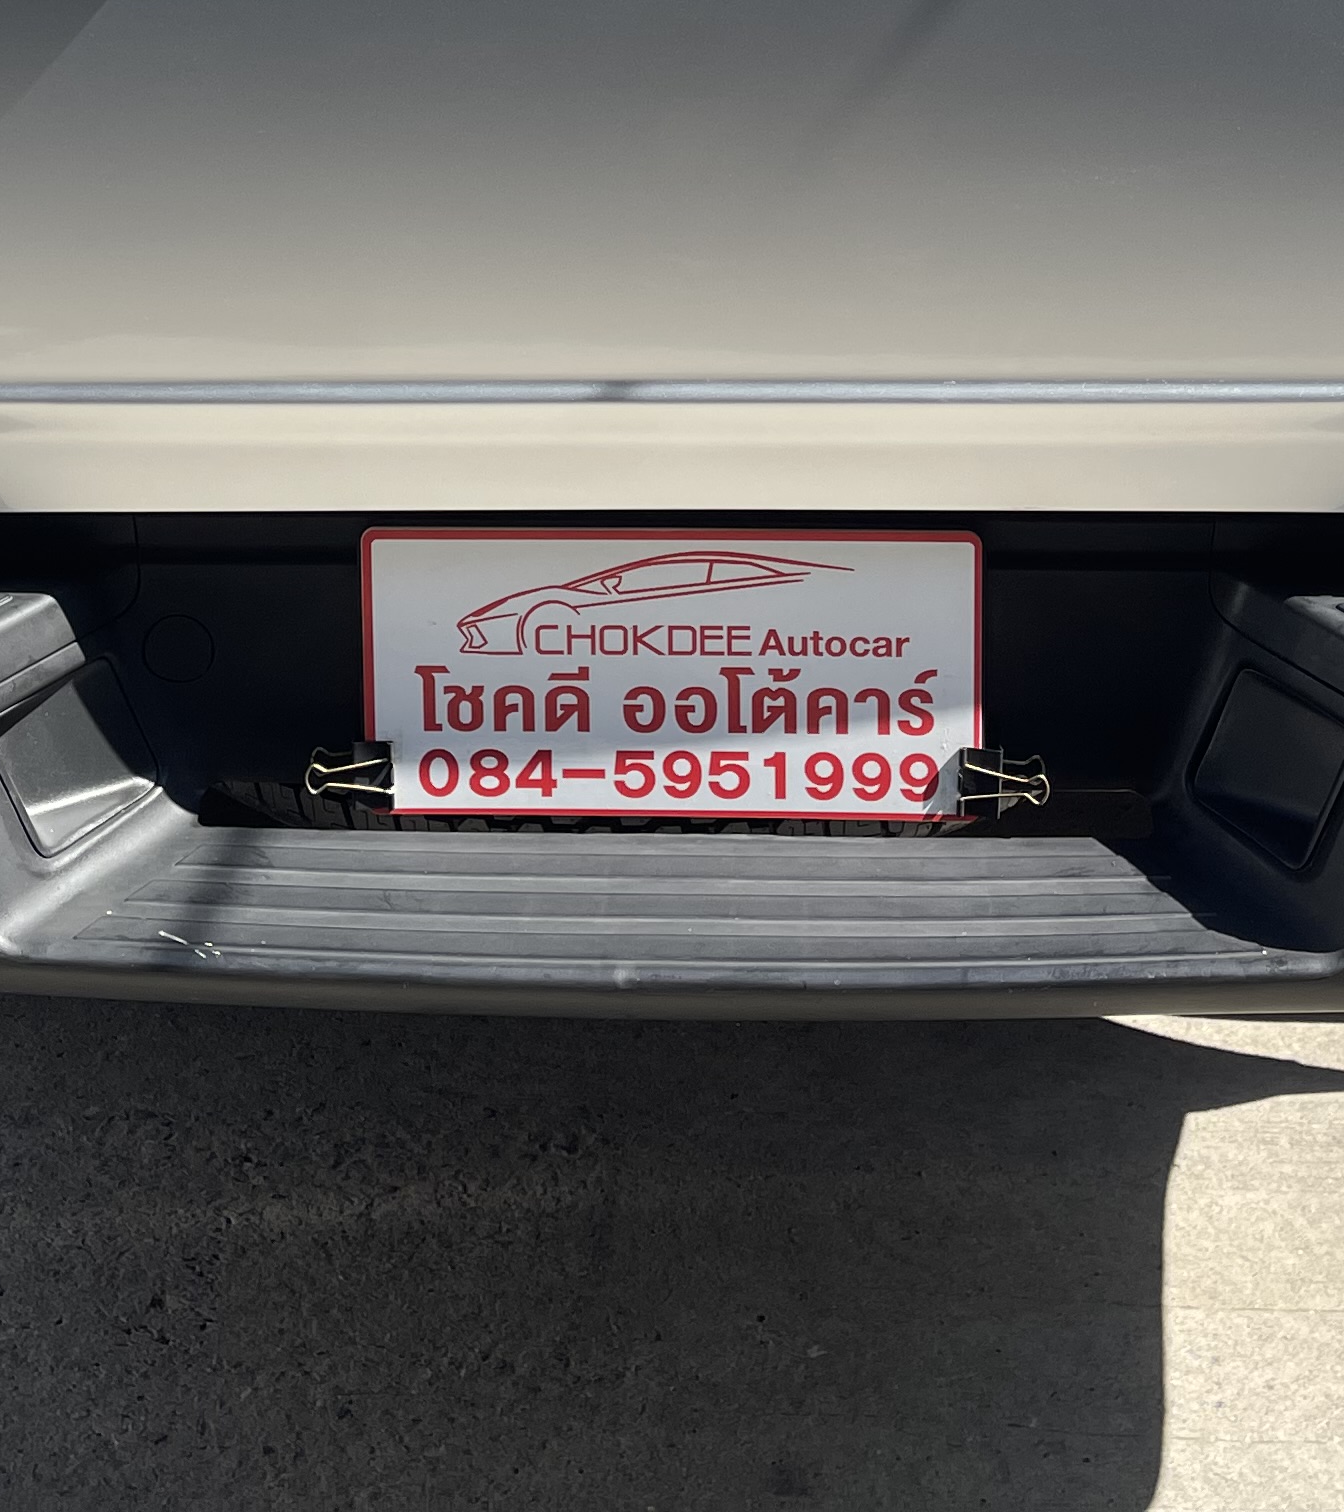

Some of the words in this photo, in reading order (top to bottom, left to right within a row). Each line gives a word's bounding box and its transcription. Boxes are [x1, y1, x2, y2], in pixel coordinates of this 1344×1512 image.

[533, 624, 753, 657] CHOKDEE
[759, 628, 910, 659] Autocar
[414, 665, 592, 734] โชคดี
[622, 666, 938, 736] ออโต้คาร์
[418, 748, 940, 804] 084-5951999
